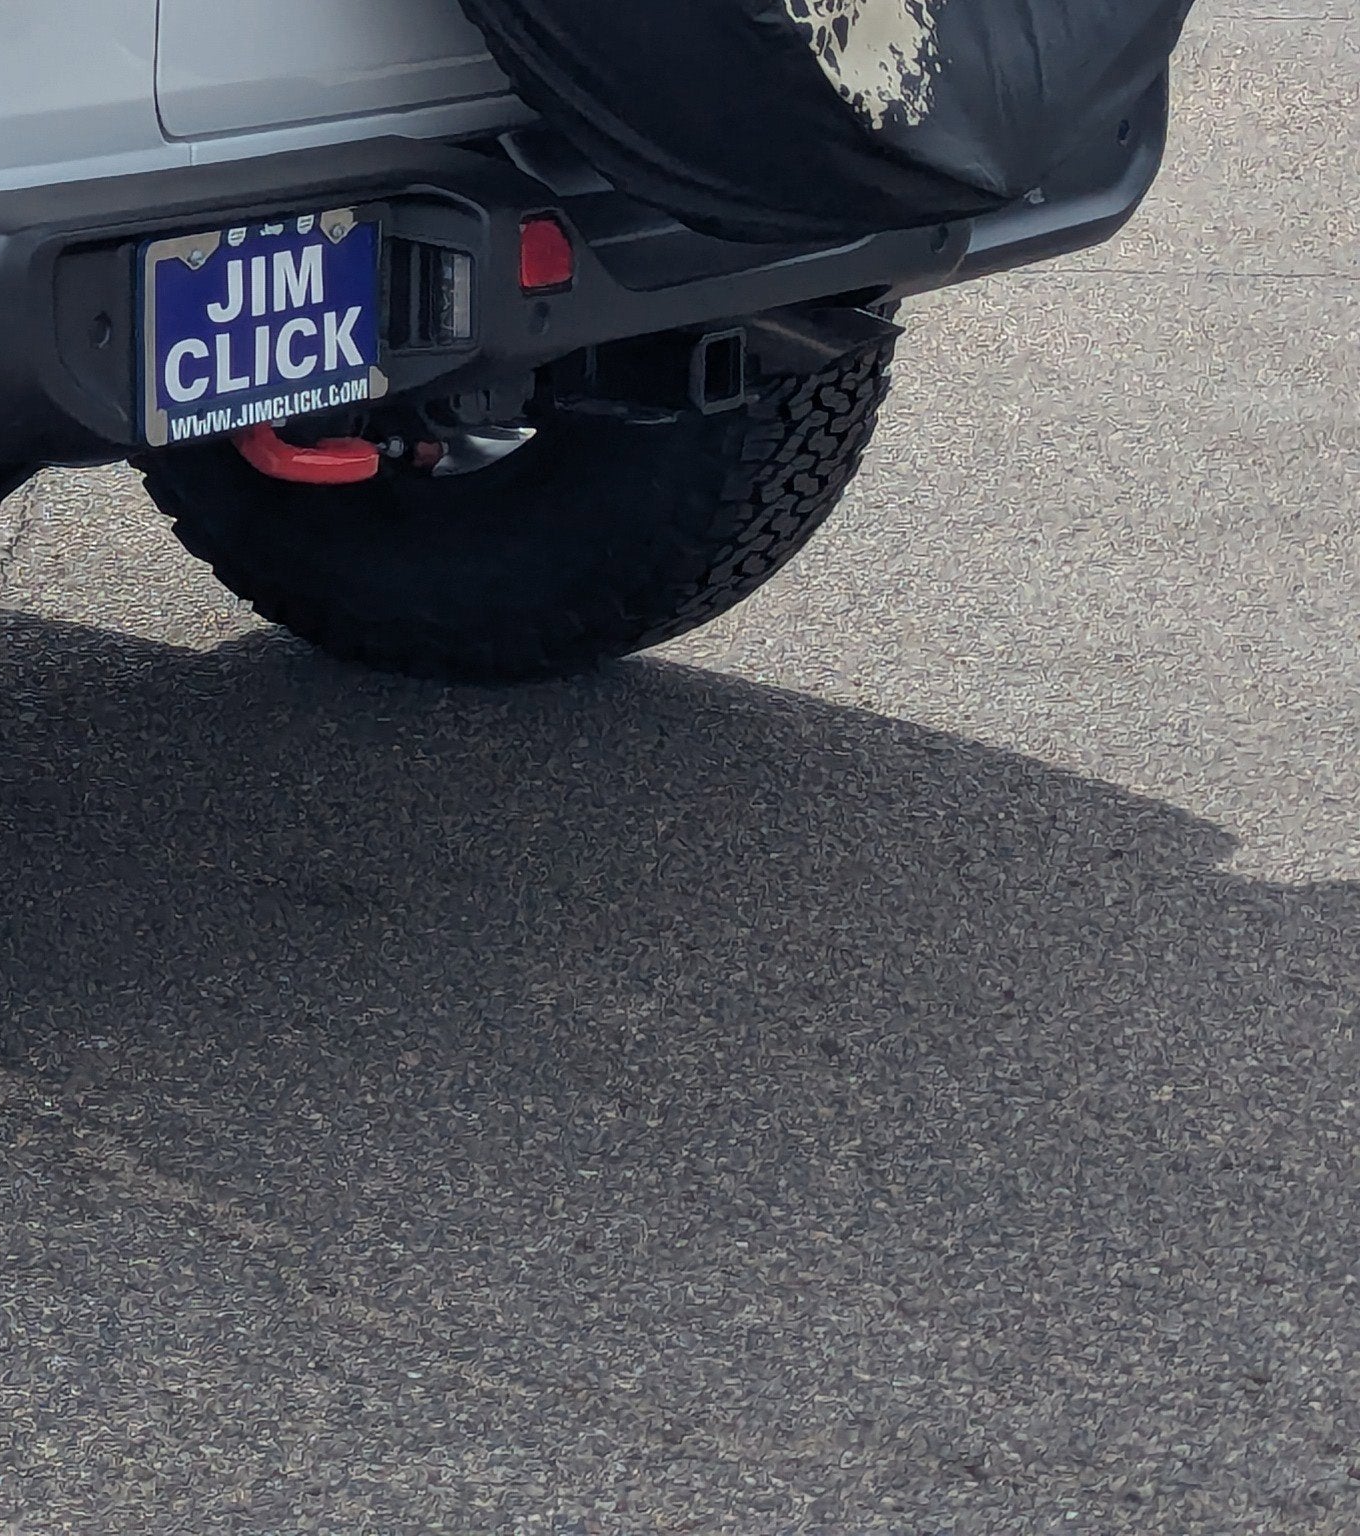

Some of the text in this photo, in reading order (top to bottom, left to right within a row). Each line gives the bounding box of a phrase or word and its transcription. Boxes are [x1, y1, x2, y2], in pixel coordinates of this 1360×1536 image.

[206, 244, 324, 323] JIM
[164, 306, 364, 403] CLICK
[171, 378, 368, 440] WWW.JIMCLICK.COM
